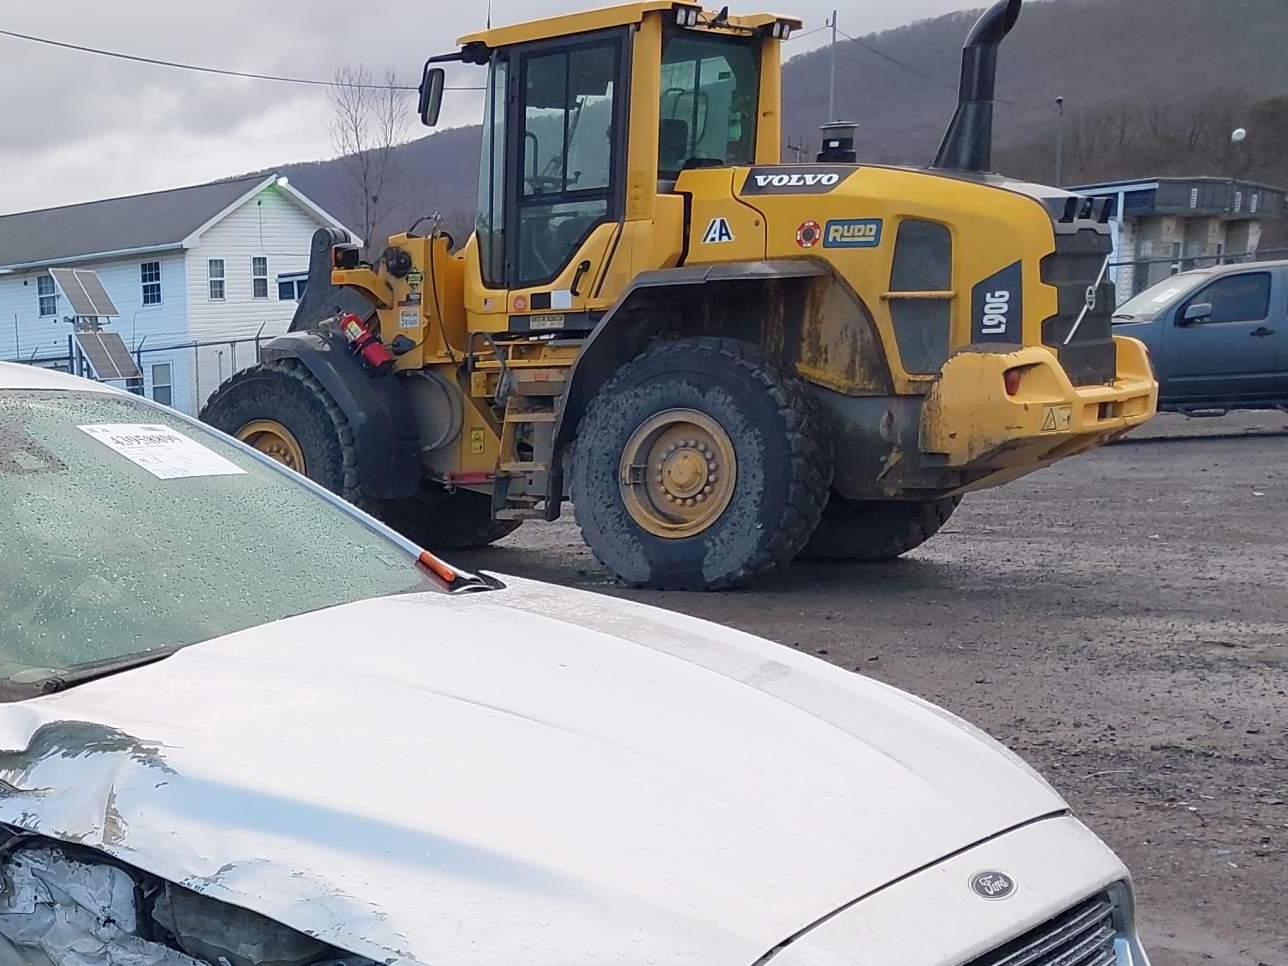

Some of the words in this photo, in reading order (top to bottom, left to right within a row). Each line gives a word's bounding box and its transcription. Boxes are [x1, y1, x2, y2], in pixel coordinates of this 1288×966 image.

[754, 174, 839, 186] VOLVO
[981, 290, 1010, 334] L90G
[979, 875, 1009, 895] Ford
